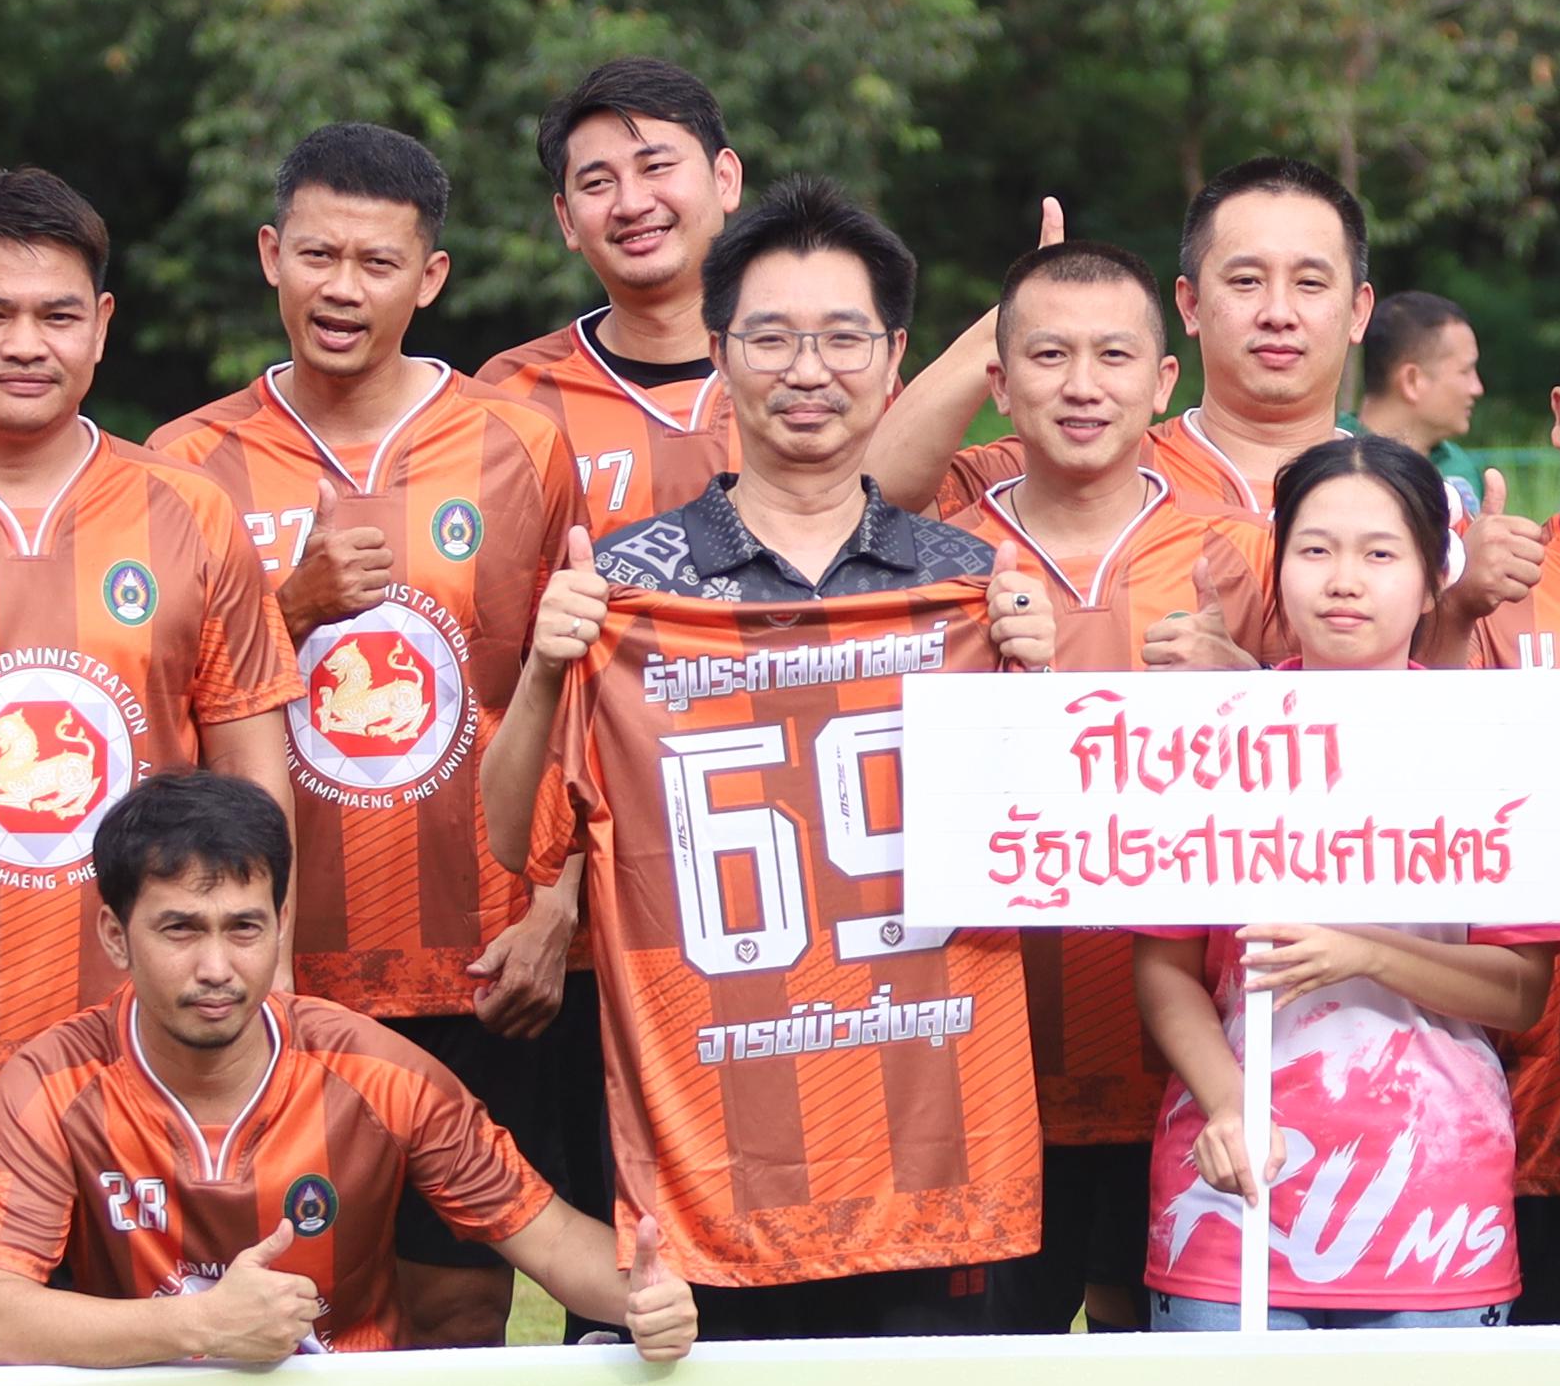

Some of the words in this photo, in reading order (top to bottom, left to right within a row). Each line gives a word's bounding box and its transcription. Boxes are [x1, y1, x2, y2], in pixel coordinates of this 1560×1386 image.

[384, 582, 470, 663] ISTRATION
[296, 770, 394, 809] KAMPHAENG
[403, 776, 440, 804] PHET
[438, 685, 480, 780] UNIVERSITY
[1064, 688, 1344, 795] ศิษย์เก่า
[67, 860, 99, 887] PHE
[658, 709, 960, 977] 69
[987, 792, 1533, 909] รัฐประศาสนศาสตร์
[1383, 1202, 1507, 1285] MS
